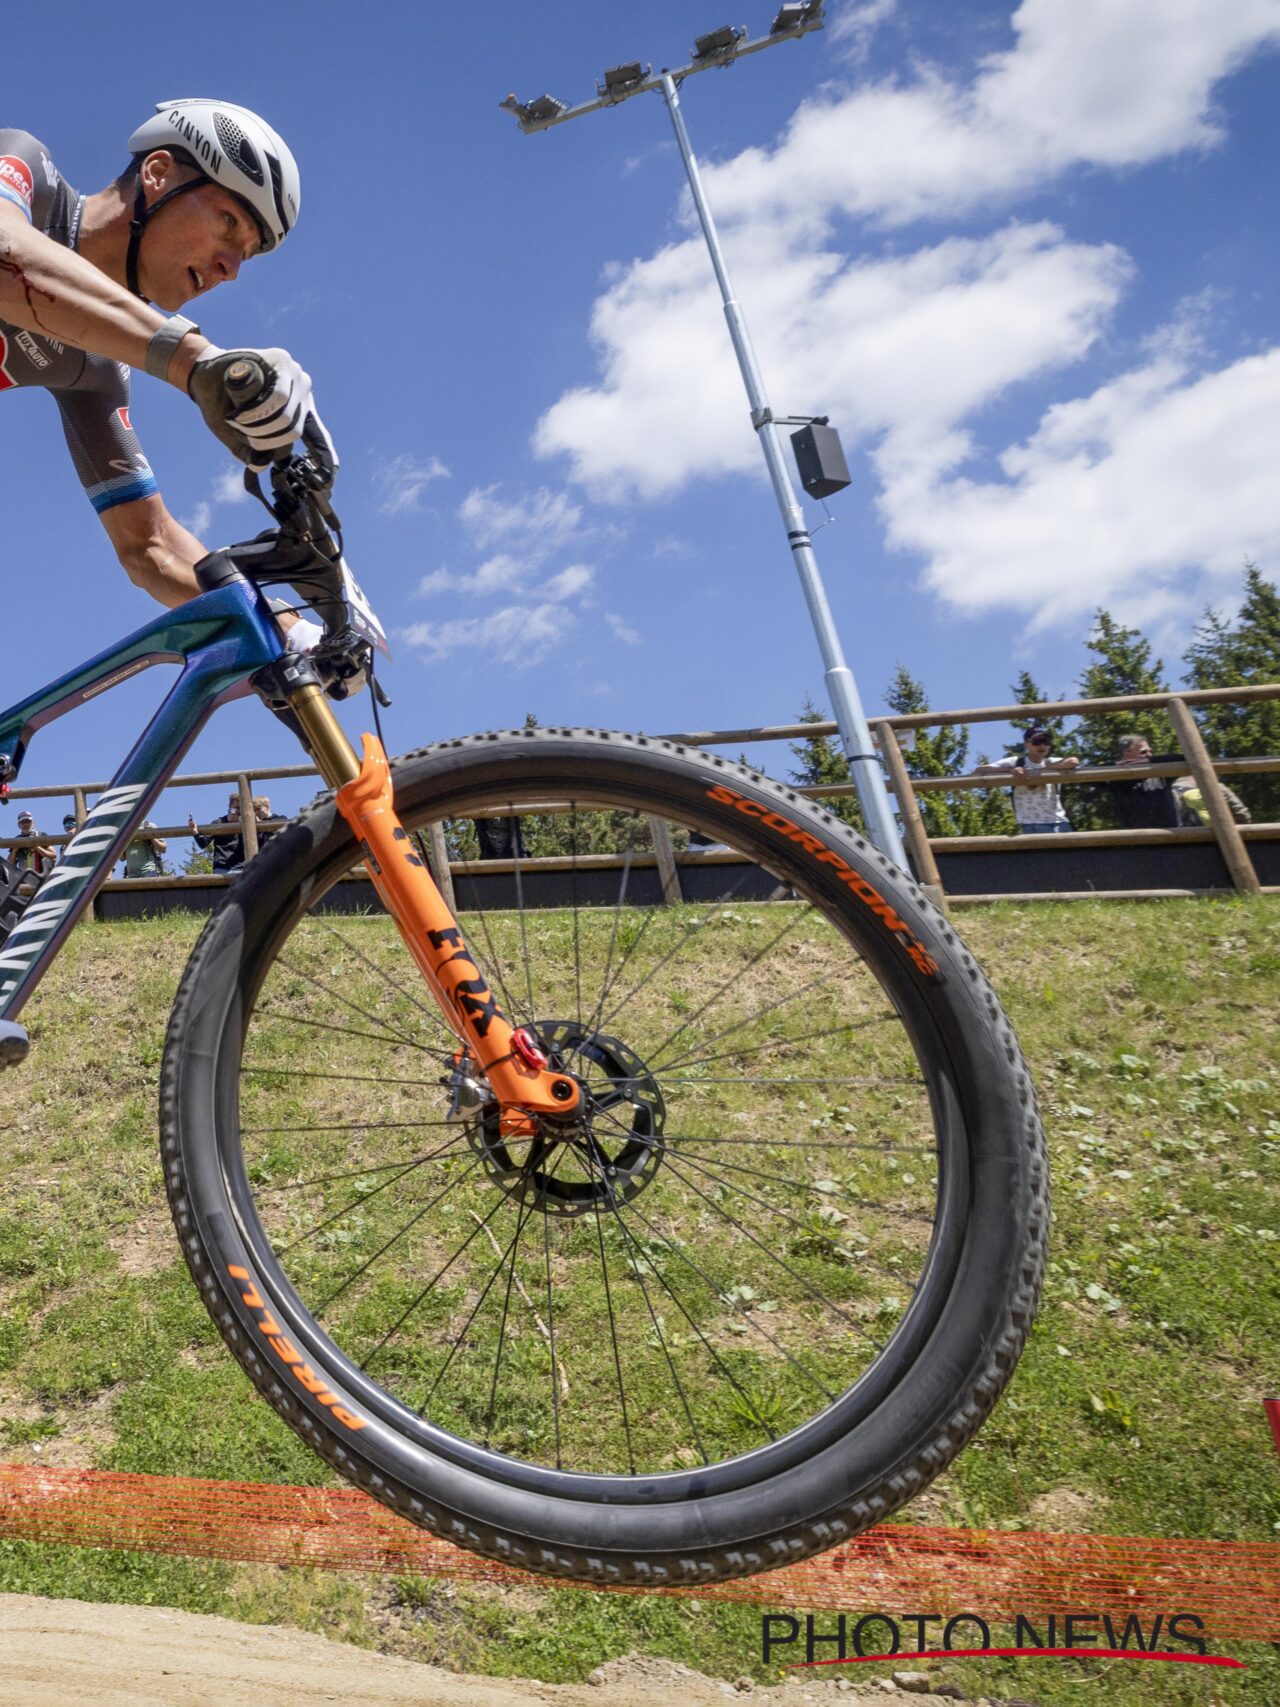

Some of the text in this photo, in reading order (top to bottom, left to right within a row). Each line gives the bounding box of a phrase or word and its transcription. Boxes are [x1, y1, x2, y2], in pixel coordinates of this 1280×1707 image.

[169, 110, 222, 175] CANYON
[706, 784, 910, 932] SCORPION
[427, 928, 507, 1038] FOX
[228, 1263, 369, 1431] PIRELLI
